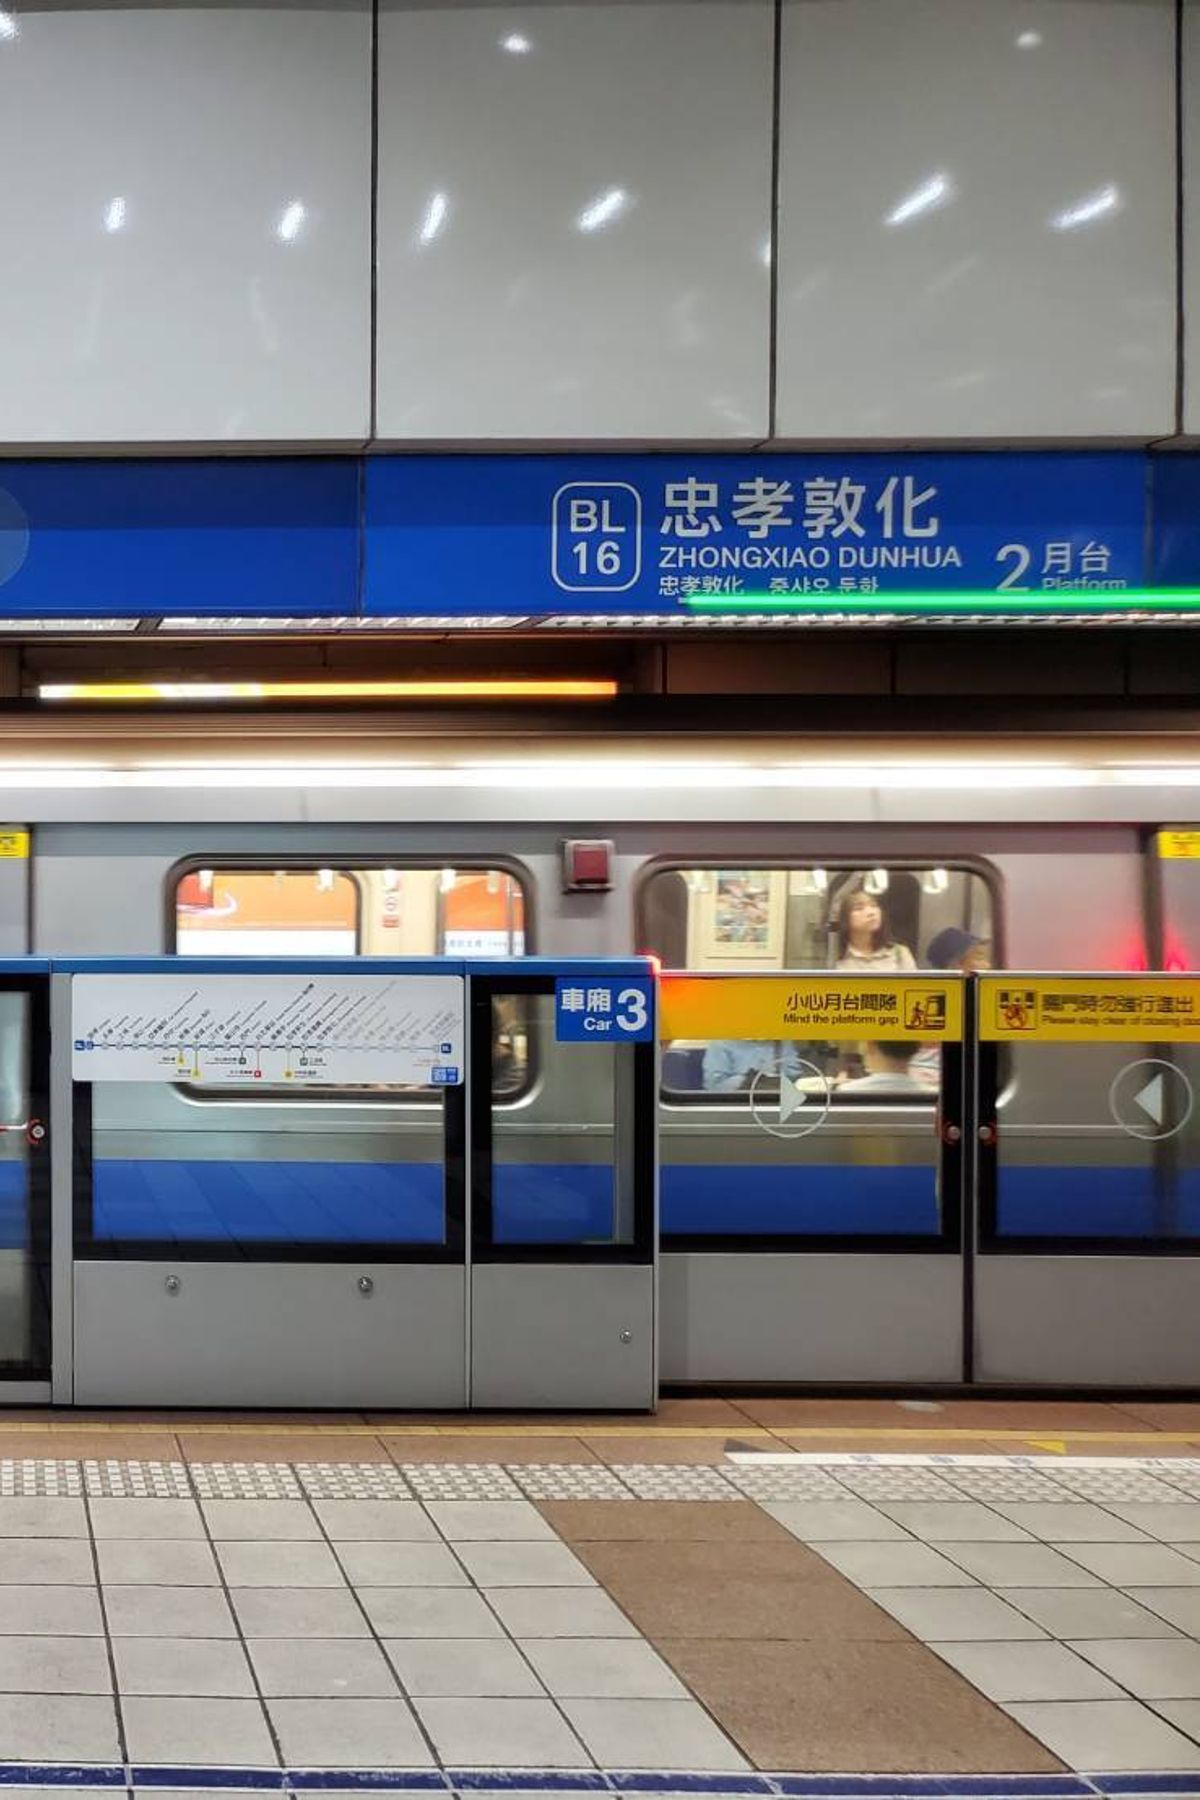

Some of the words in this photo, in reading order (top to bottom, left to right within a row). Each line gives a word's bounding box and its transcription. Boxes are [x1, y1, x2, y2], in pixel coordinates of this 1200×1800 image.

[570, 499, 627, 533] BL
[660, 476, 938, 539] 忠孝敦化
[572, 541, 621, 575] 16
[659, 547, 830, 569] ZHONGXIAO
[838, 546, 963, 568] DUNHUA
[995, 544, 1031, 592] 2
[1041, 541, 1112, 575] 月台
[658, 575, 745, 596] 忠孝敦化
[1041, 576, 1128, 592] Platform
[561, 988, 611, 1012] 車廂
[616, 988, 648, 1031] 3
[786, 993, 897, 1011] 小心月台間隙
[584, 1017, 612, 1031] Car
[783, 1014, 810, 1024] Mind
[812, 1014, 829, 1024] the
[831, 1013, 876, 1026] platform
[878, 1015, 899, 1026] gap
